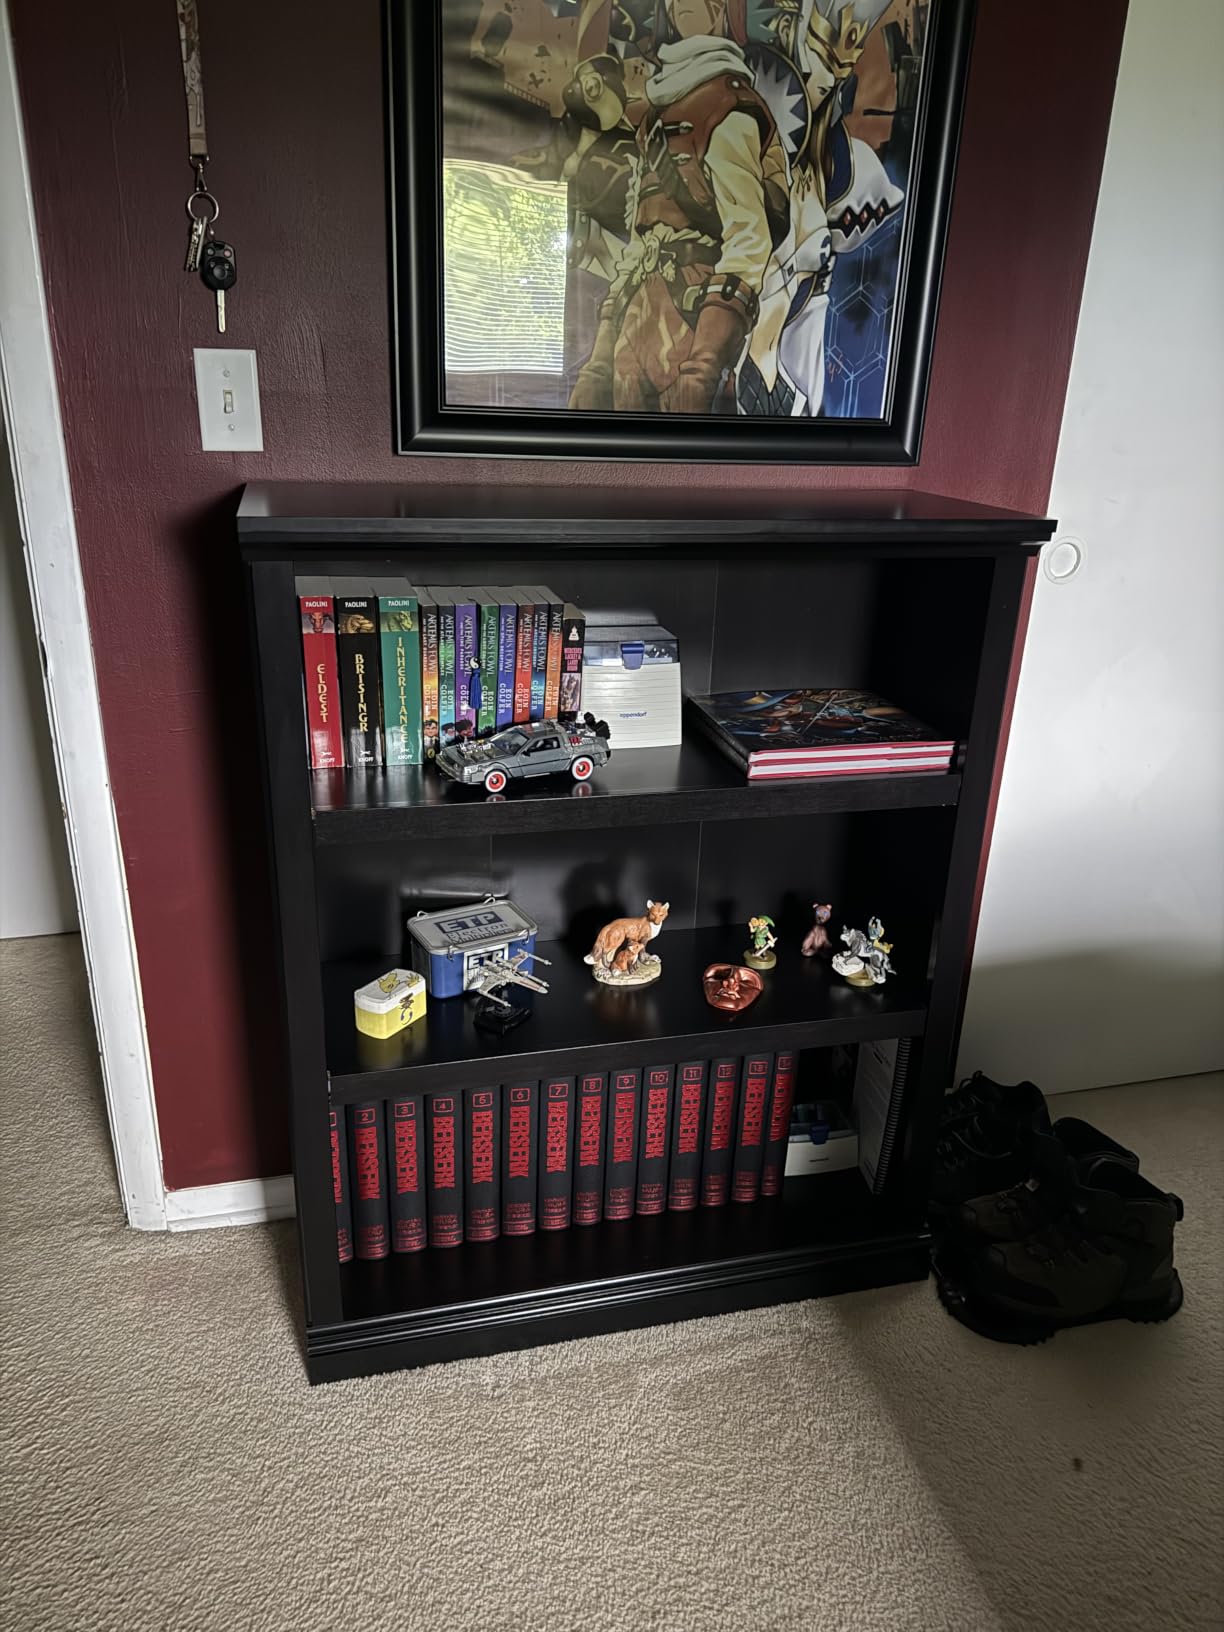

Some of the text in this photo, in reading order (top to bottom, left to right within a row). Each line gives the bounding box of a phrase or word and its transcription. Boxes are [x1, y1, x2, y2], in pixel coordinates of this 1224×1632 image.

[428, 614, 437, 648] ARTEMIS
[445, 615, 454, 676] ARTEMIS FOWL
[464, 615, 472, 650] ARTEMIS
[487, 616, 496, 677] ARTEMIS FOWL
[505, 614, 514, 674] ARTEMIS FOWL
[522, 614, 532, 672] ARTEMIS FOWL
[537, 612, 548, 672] ARTEMIS FOWL
[317, 664, 328, 723] ELDEST
[355, 654, 368, 732] BRISINGR
[396, 636, 408, 744] INHERITANCE
[439, 912, 496, 932] ETP
[447, 923, 508, 940] Electron
[509, 1106, 530, 1178] BERSERK
[547, 1101, 568, 1173] BERSERK
[580, 1096, 601, 1166] BERSERK
[613, 1092, 635, 1164] BERSERK
[645, 1088, 668, 1159] BERSERK
[678, 1084, 701, 1154] BERSERK
[741, 1078, 766, 1147] BERSERK
[395, 1120, 418, 1194] BERSERK
[433, 1117, 455, 1189] BERSERK
[472, 1111, 493, 1184] BERSERK
